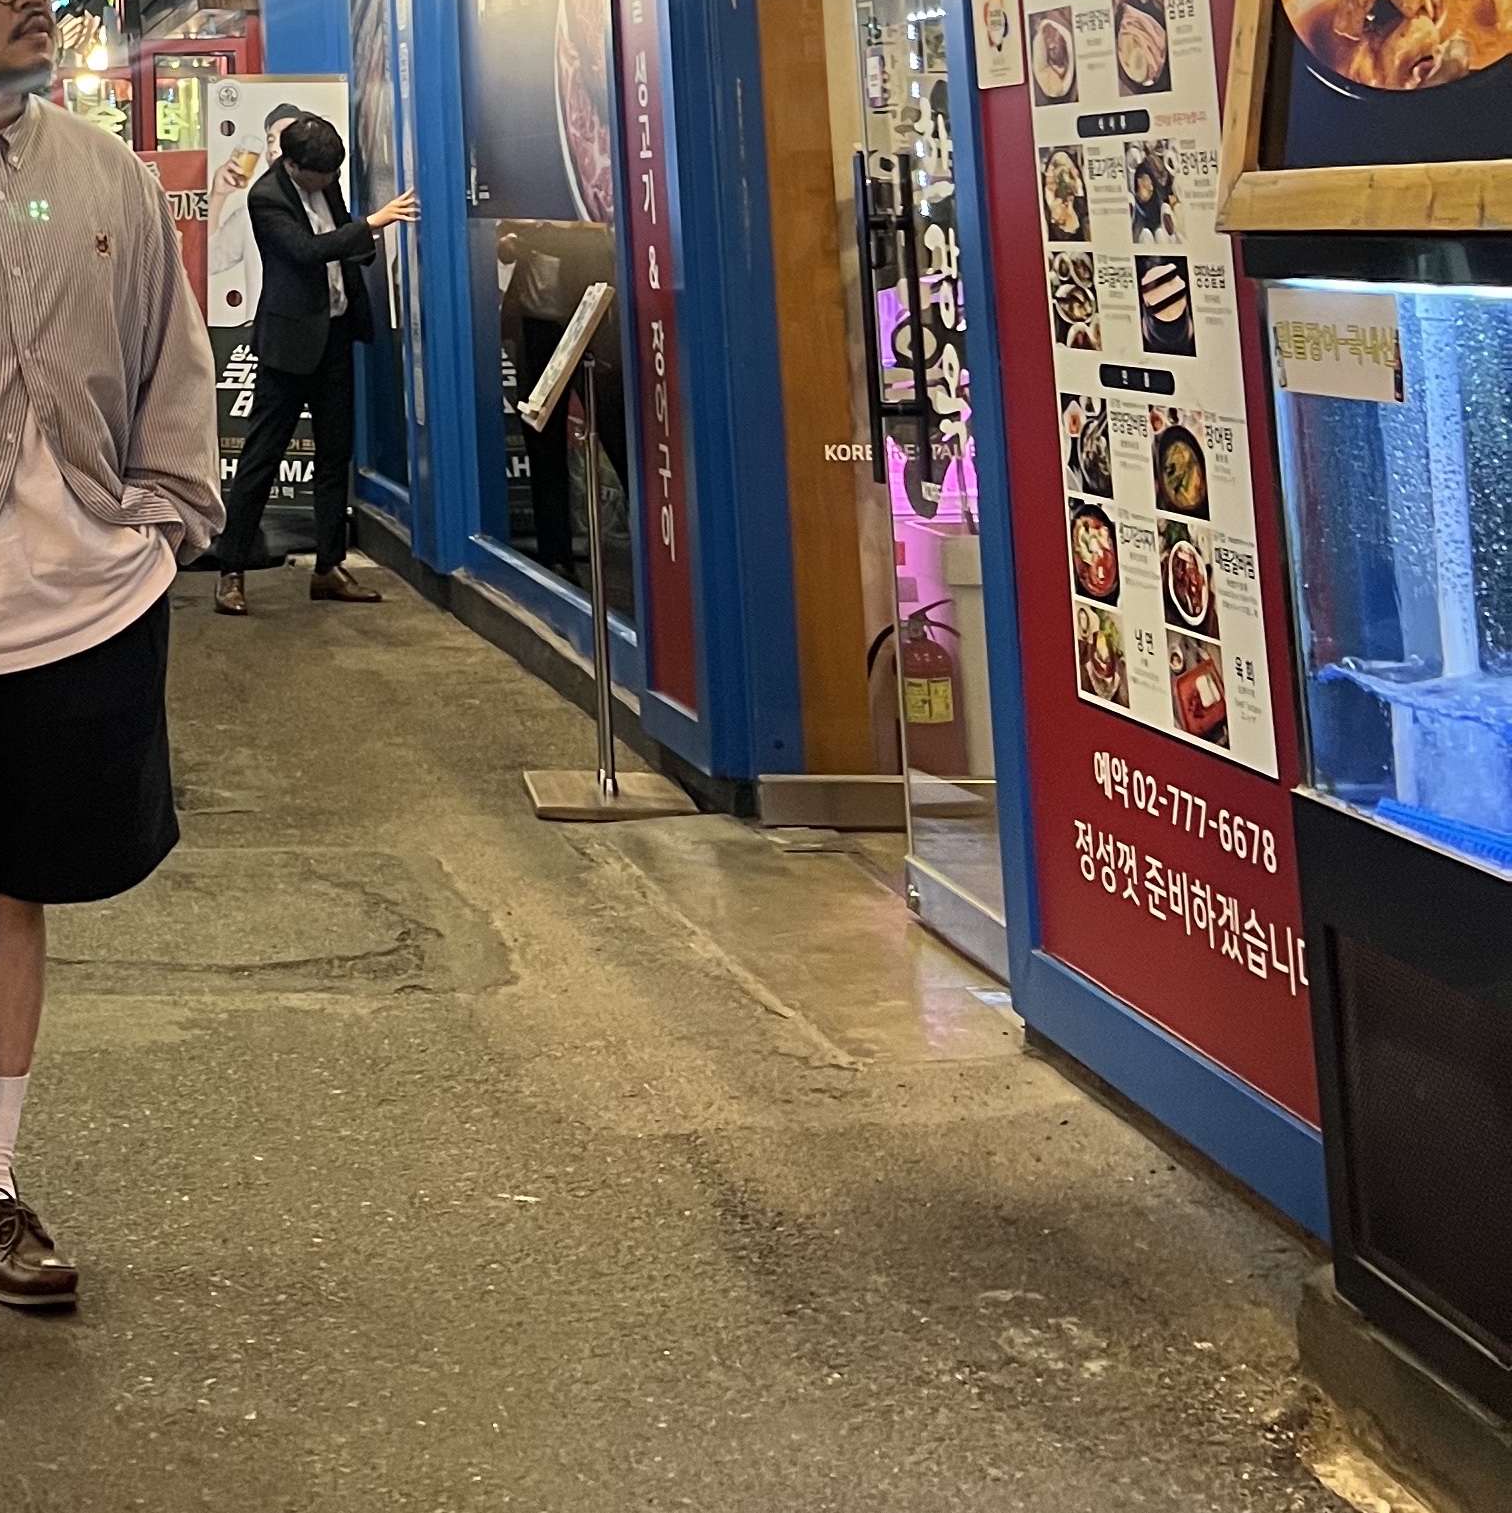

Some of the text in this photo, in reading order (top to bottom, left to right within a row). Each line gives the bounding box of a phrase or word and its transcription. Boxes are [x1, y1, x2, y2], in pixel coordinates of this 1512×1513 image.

[634, 50, 657, 225] 생고기
[648, 245, 661, 290] &
[650, 319, 676, 563] 장어구이
[824, 444, 873, 461] KORE
[1134, 628, 1155, 656] 냉면
[1234, 656, 1256, 687] 육회
[1092, 749, 1278, 874] 예약 02-777-6678
[1074, 819, 1141, 907] 정성껏
